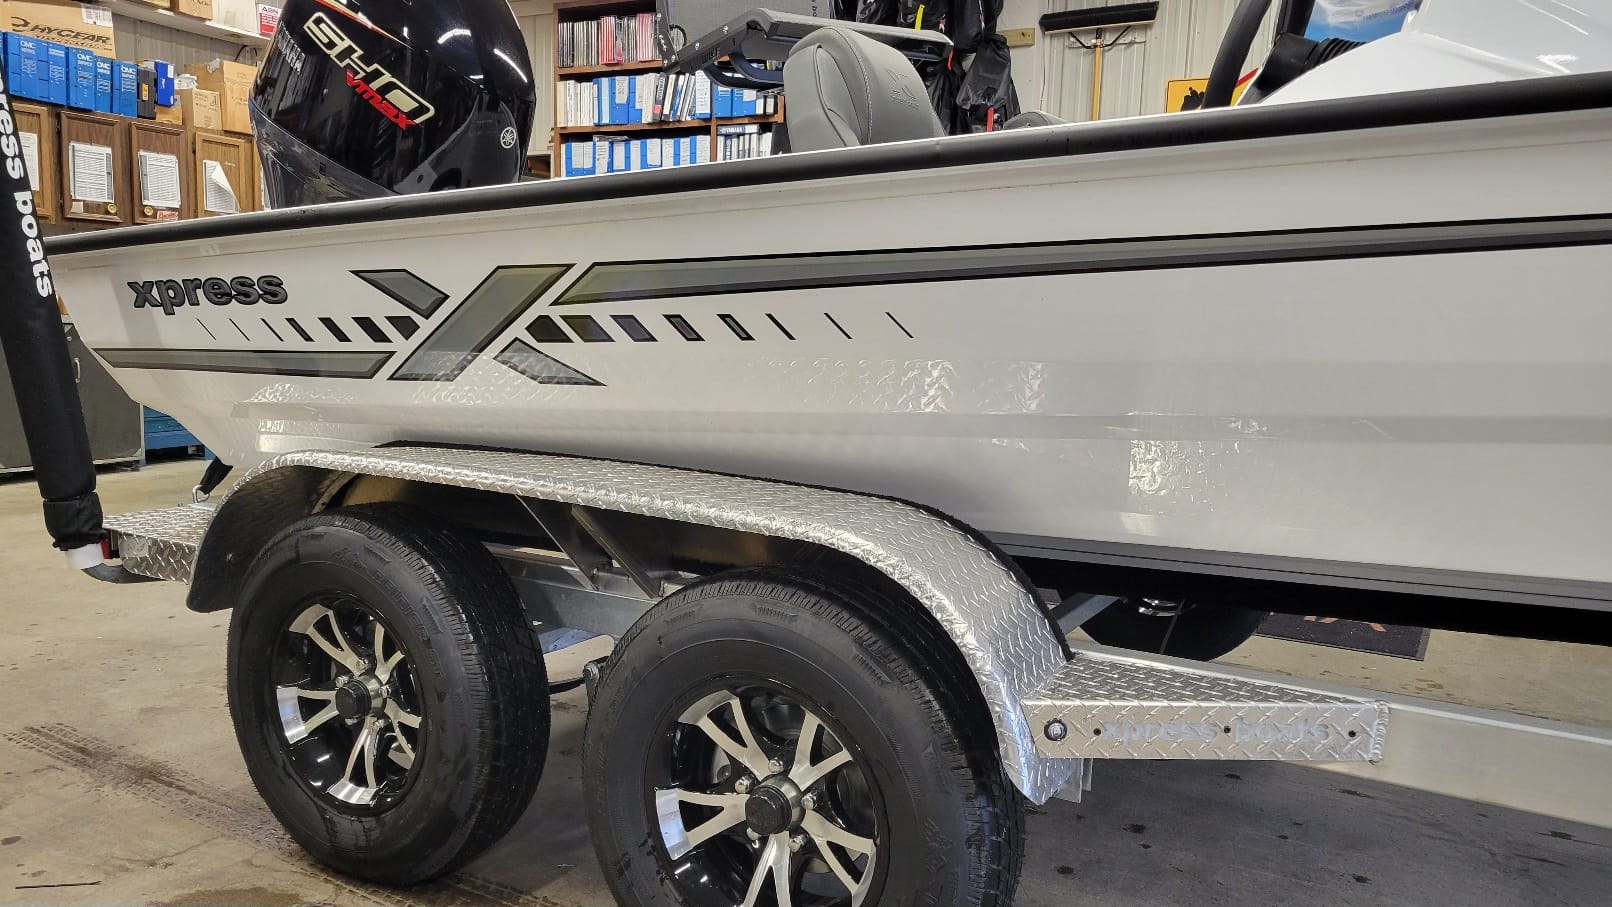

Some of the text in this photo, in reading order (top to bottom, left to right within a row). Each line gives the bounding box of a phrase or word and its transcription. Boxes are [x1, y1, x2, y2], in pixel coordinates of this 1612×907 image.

[76, 53, 93, 61] OMC
[96, 61, 110, 70] OMC
[121, 66, 137, 74] OMC
[303, 11, 435, 124] SHO
[14, 190, 52, 298] boats
[127, 275, 288, 316] xpress
[1101, 717, 1330, 745] xpress boats
